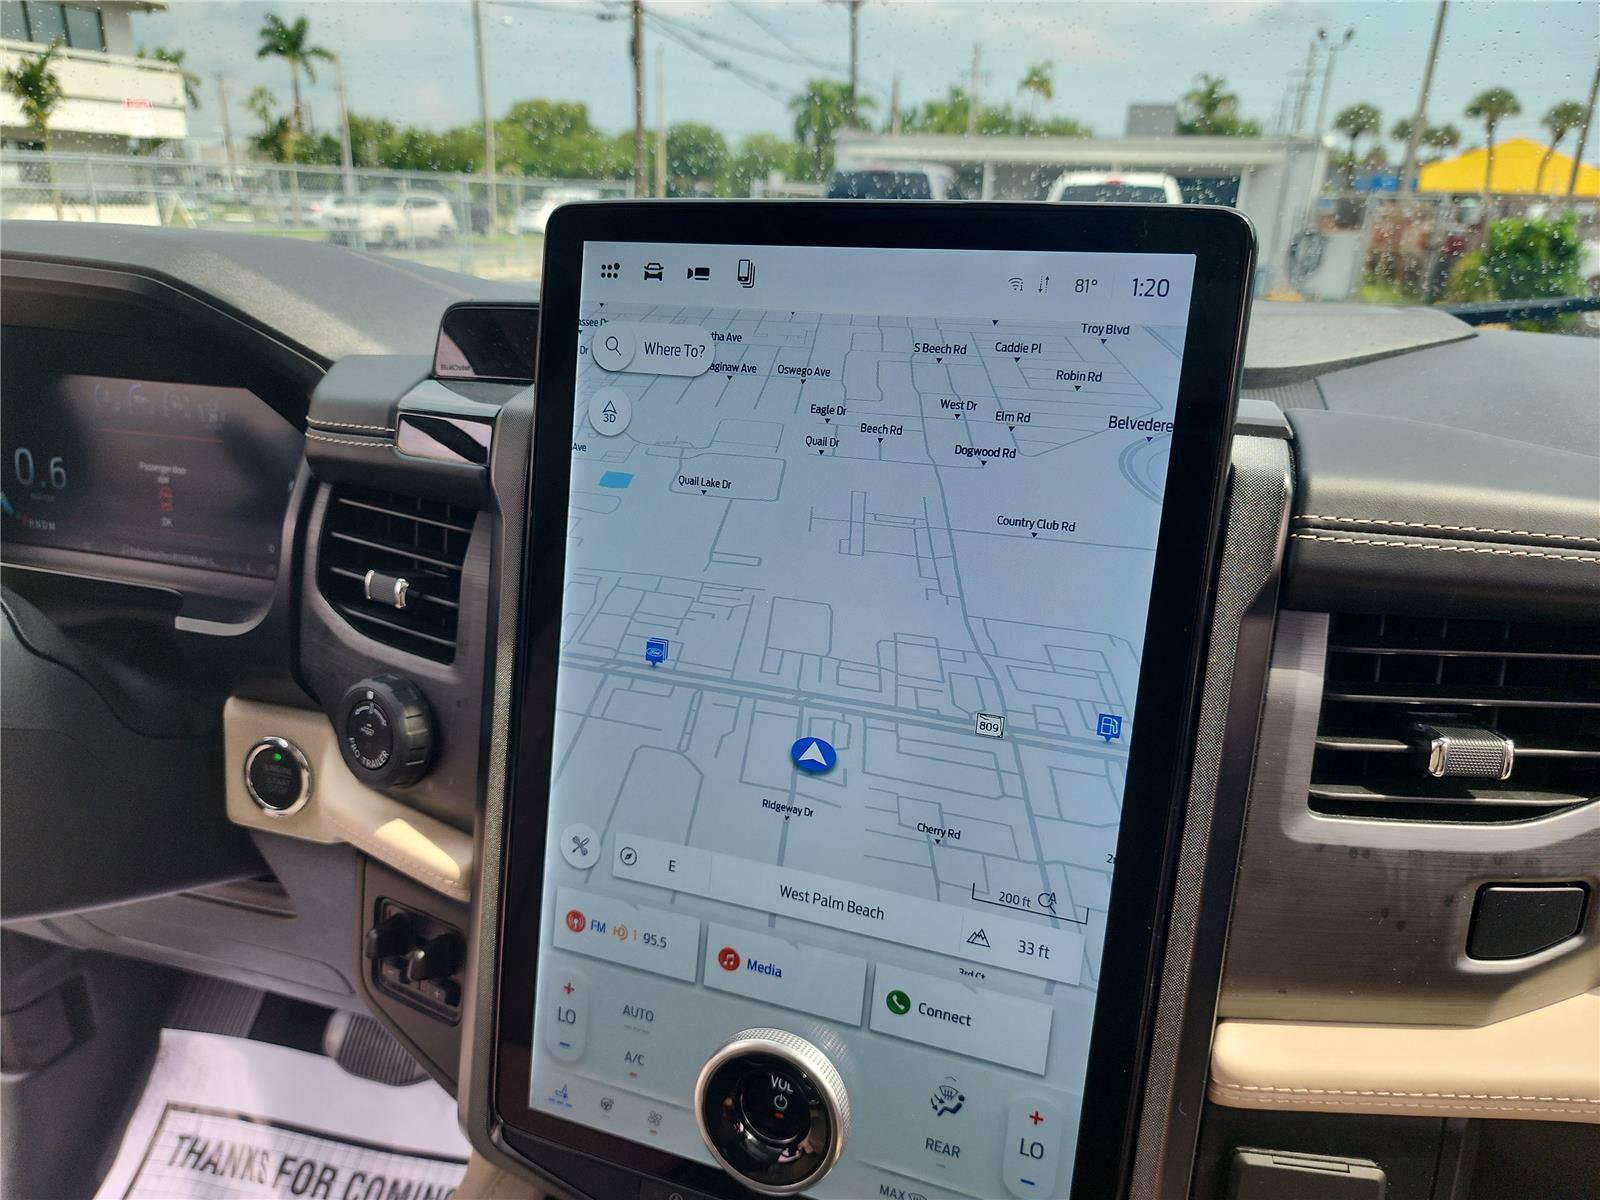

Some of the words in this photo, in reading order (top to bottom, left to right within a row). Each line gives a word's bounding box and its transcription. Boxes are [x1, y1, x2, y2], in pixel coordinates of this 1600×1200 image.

[1074, 278, 1098, 294] 81°
[1132, 278, 1170, 298] 1:20
[711, 331, 725, 342] tha
[726, 333, 742, 343] Ave
[1081, 323, 1104, 336] Troy
[1105, 324, 1130, 335] Blvd
[644, 341, 682, 356] Where
[684, 344, 706, 358] To?
[914, 343, 921, 353] S
[922, 342, 951, 354] Beech
[953, 344, 967, 355] Rd
[995, 341, 1028, 353] Caddie
[1030, 343, 1042, 354] Pl
[709, 362, 739, 375] aginaw
[740, 365, 757, 375] Ave
[777, 364, 813, 378] Oswego
[814, 366, 831, 377] Ave
[1056, 370, 1086, 382] Robin
[1088, 371, 1103, 382] Rd
[810, 404, 834, 417] Eagle
[836, 406, 847, 416] Dr
[940, 399, 964, 411] West
[965, 401, 978, 412] Dr
[603, 413, 616, 423] 3D
[995, 411, 1014, 422] Elm
[1016, 412, 1031, 423] Rd
[1108, 416, 1174, 433] Belvedere
[860, 423, 887, 435] Beech
[888, 425, 903, 436] Rd
[805, 435, 828, 448] Quail
[829, 437, 840, 448] Dr
[954, 444, 1000, 459] Dogwood
[1001, 447, 1017, 458] Rd
[14, 446, 67, 490] 0.6
[678, 475, 700, 488] Quail
[701, 476, 721, 487] Lake
[722, 479, 732, 489] Dr
[997, 515, 1036, 531] Country
[1037, 519, 1059, 531] Club
[1061, 521, 1076, 532] Rd
[979, 721, 1000, 733] 809
[362, 750, 390, 769] TRAILER
[762, 799, 803, 816] Ridgeway
[803, 808, 814, 817] Dr
[917, 822, 946, 839] Cherry
[948, 829, 961, 840] Rd
[669, 860, 676, 872] E
[779, 885, 811, 903] West
[812, 891, 844, 911] Palm
[847, 900, 885, 920] Beach
[999, 891, 1023, 905] 200
[1023, 897, 1031, 908] ft
[590, 919, 606, 933] FM
[643, 932, 667, 949] 95.5
[1017, 939, 1035, 955] 33
[1038, 943, 1050, 959] ft
[747, 959, 782, 978] Media
[557, 1006, 577, 1024] LO
[622, 1004, 654, 1022] AUTO
[918, 1001, 972, 1027] Connect
[624, 1051, 645, 1066] A/C
[925, 1137, 961, 1159] REAR
[1019, 1138, 1044, 1160] LO
[166, 1135, 269, 1185] THANKS
[276, 1156, 337, 1200] FOR
[342, 1171, 457, 1200] COMIN
[879, 1183, 906, 1200] MAX
